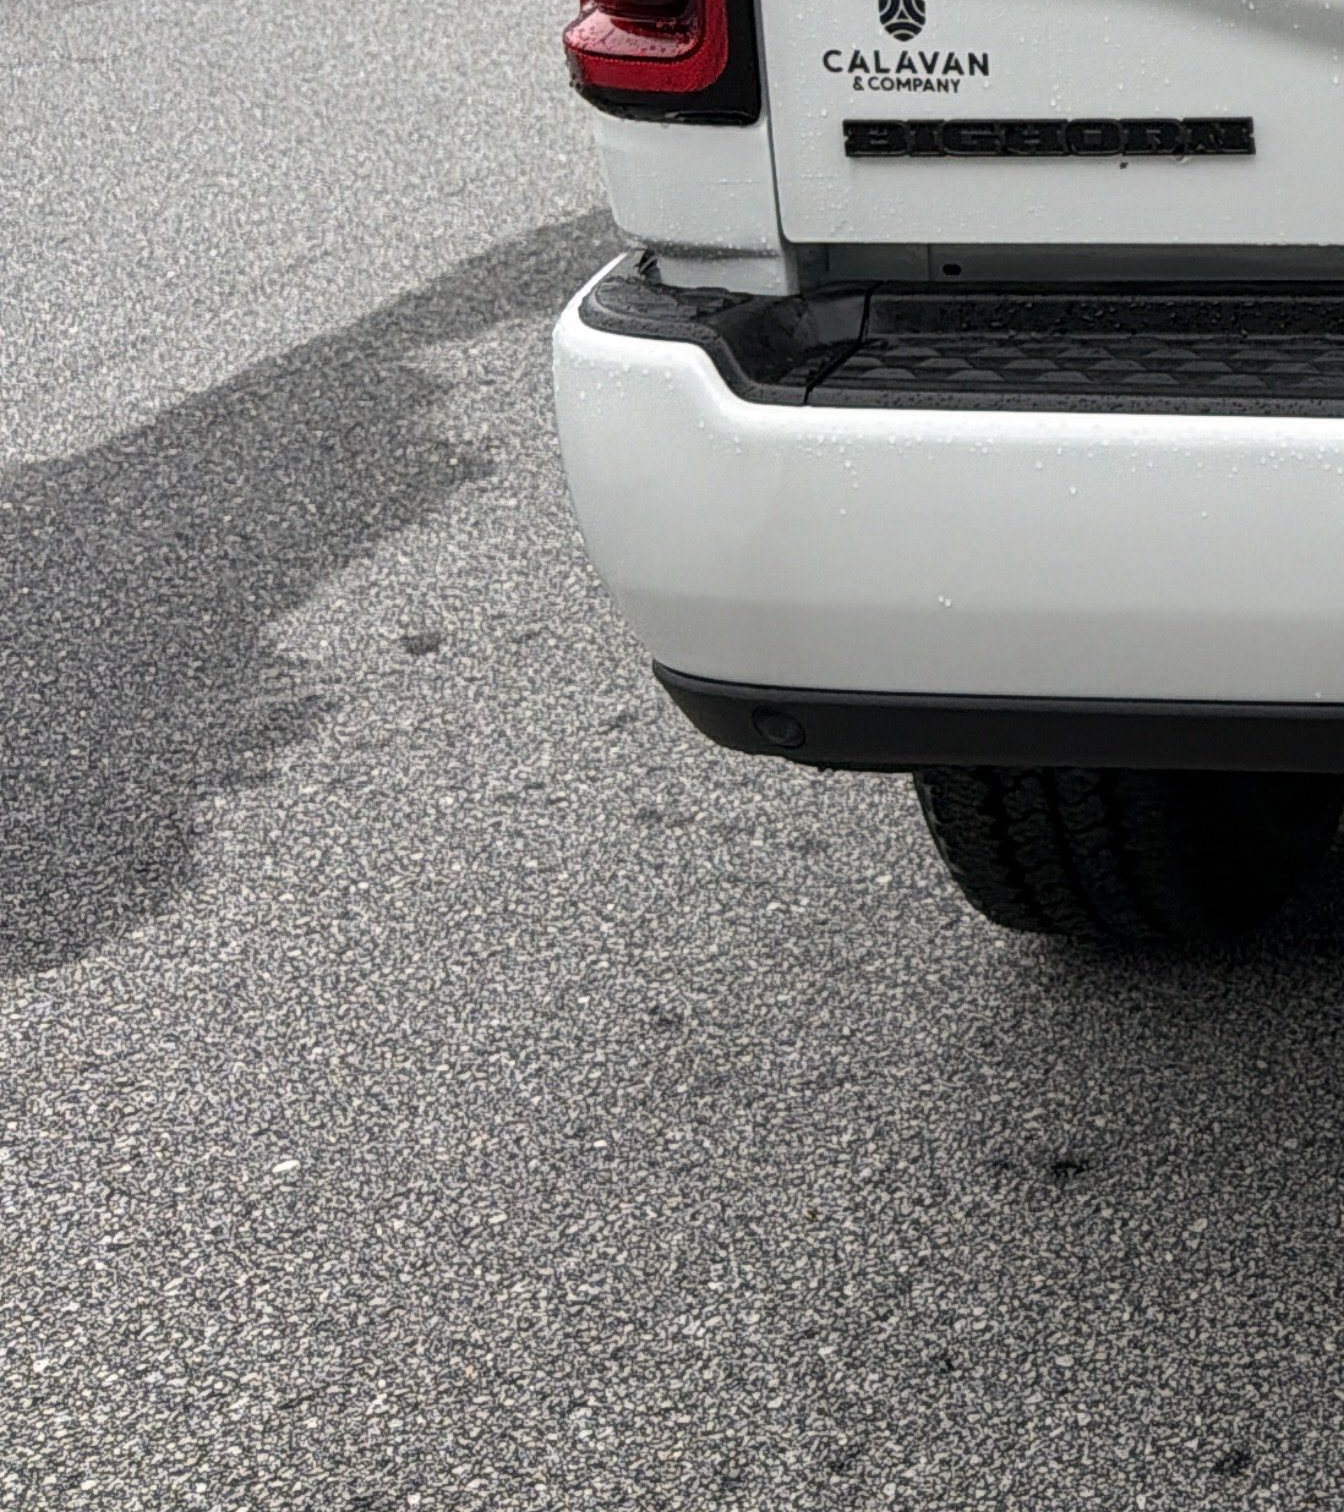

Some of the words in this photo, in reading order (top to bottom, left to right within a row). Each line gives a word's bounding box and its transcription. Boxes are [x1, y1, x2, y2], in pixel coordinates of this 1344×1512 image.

[823, 49, 990, 77] CALAVAN
[852, 76, 865, 91] &
[868, 76, 961, 93] COMPANY
